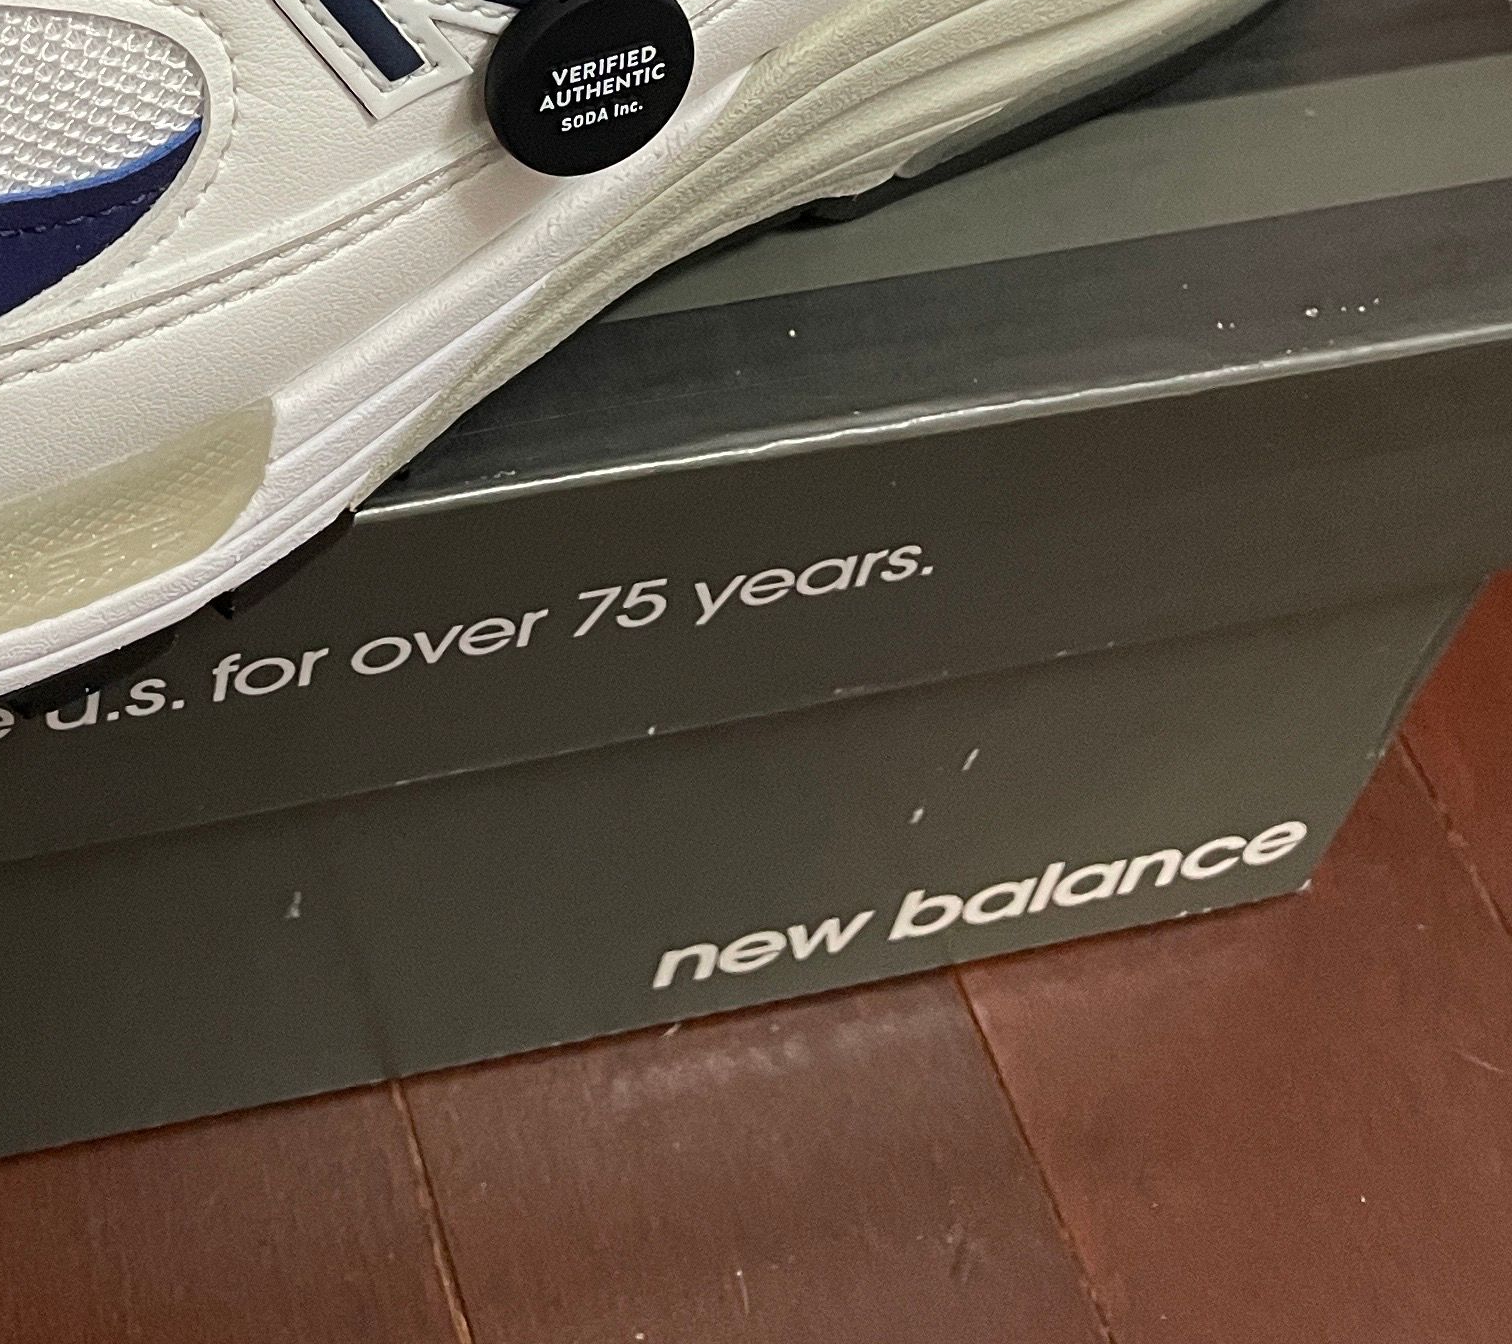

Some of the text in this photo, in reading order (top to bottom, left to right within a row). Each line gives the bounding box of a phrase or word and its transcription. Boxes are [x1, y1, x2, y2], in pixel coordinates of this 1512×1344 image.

[539, 62, 666, 112] AUTHENTIC
[552, 45, 657, 86] VERIFIED
[561, 101, 644, 132] SODA Inc.
[211, 647, 330, 703] for
[349, 607, 550, 675] over
[572, 578, 669, 639] 75
[693, 544, 935, 626] years.
[652, 819, 1309, 989] new balance
